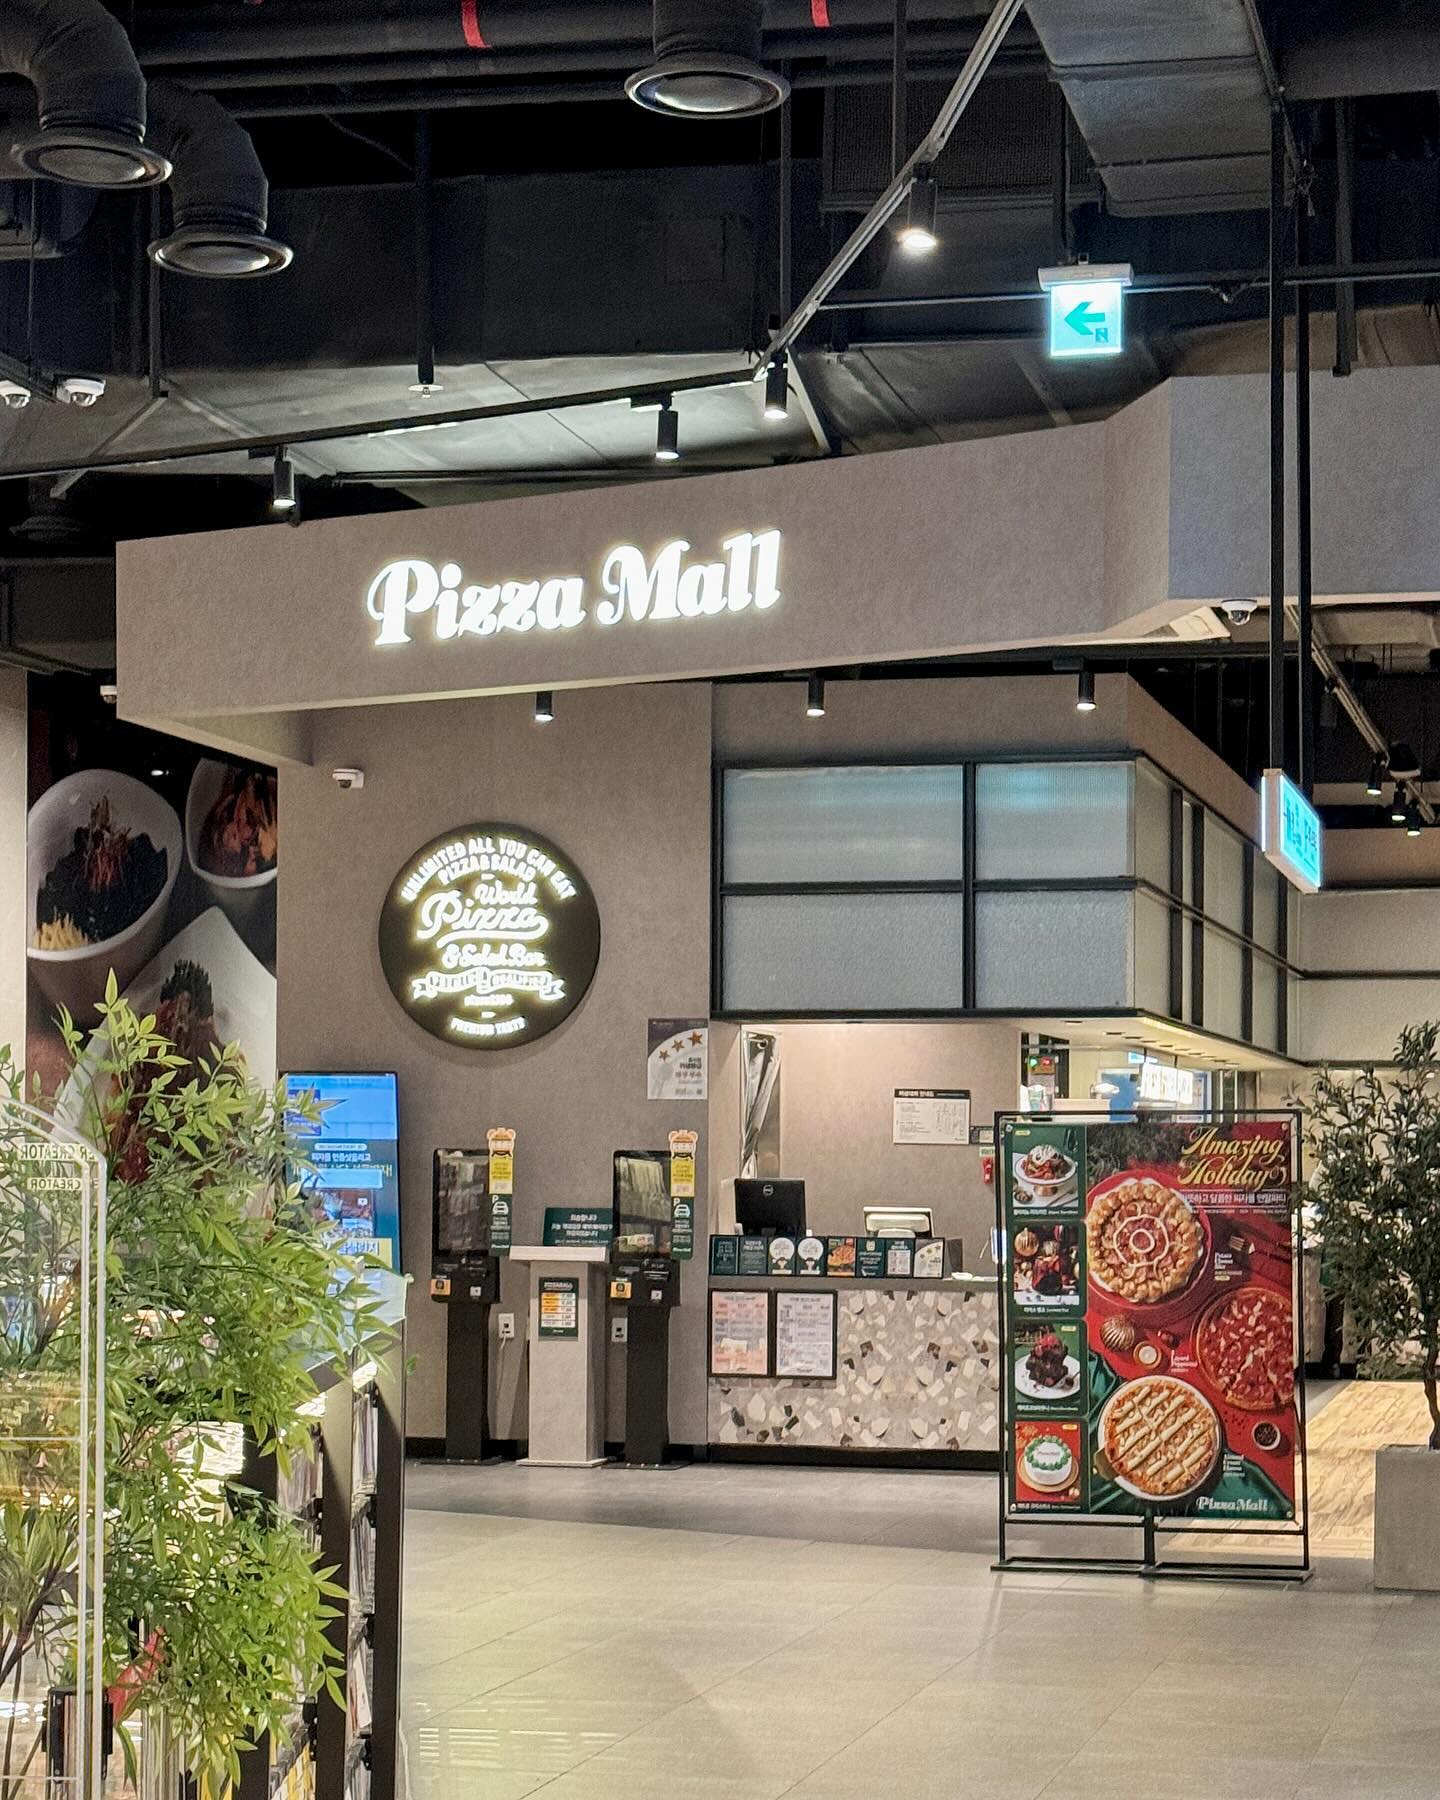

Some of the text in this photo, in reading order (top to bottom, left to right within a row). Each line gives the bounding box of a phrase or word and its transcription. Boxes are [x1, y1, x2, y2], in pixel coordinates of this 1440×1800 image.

[367, 529, 782, 645] Pizza Mall
[437, 856, 480, 886] PIZZA
[468, 837, 496, 855] ALL
[499, 838, 528, 860] YOU
[526, 848, 557, 877] CAN
[550, 870, 577, 900] EAT
[416, 889, 549, 948] Pizza
[1181, 1127, 1284, 1165] Amazing
[1178, 1155, 1287, 1192] Holiday
[1196, 1496, 1269, 1512] Pizza Mall
